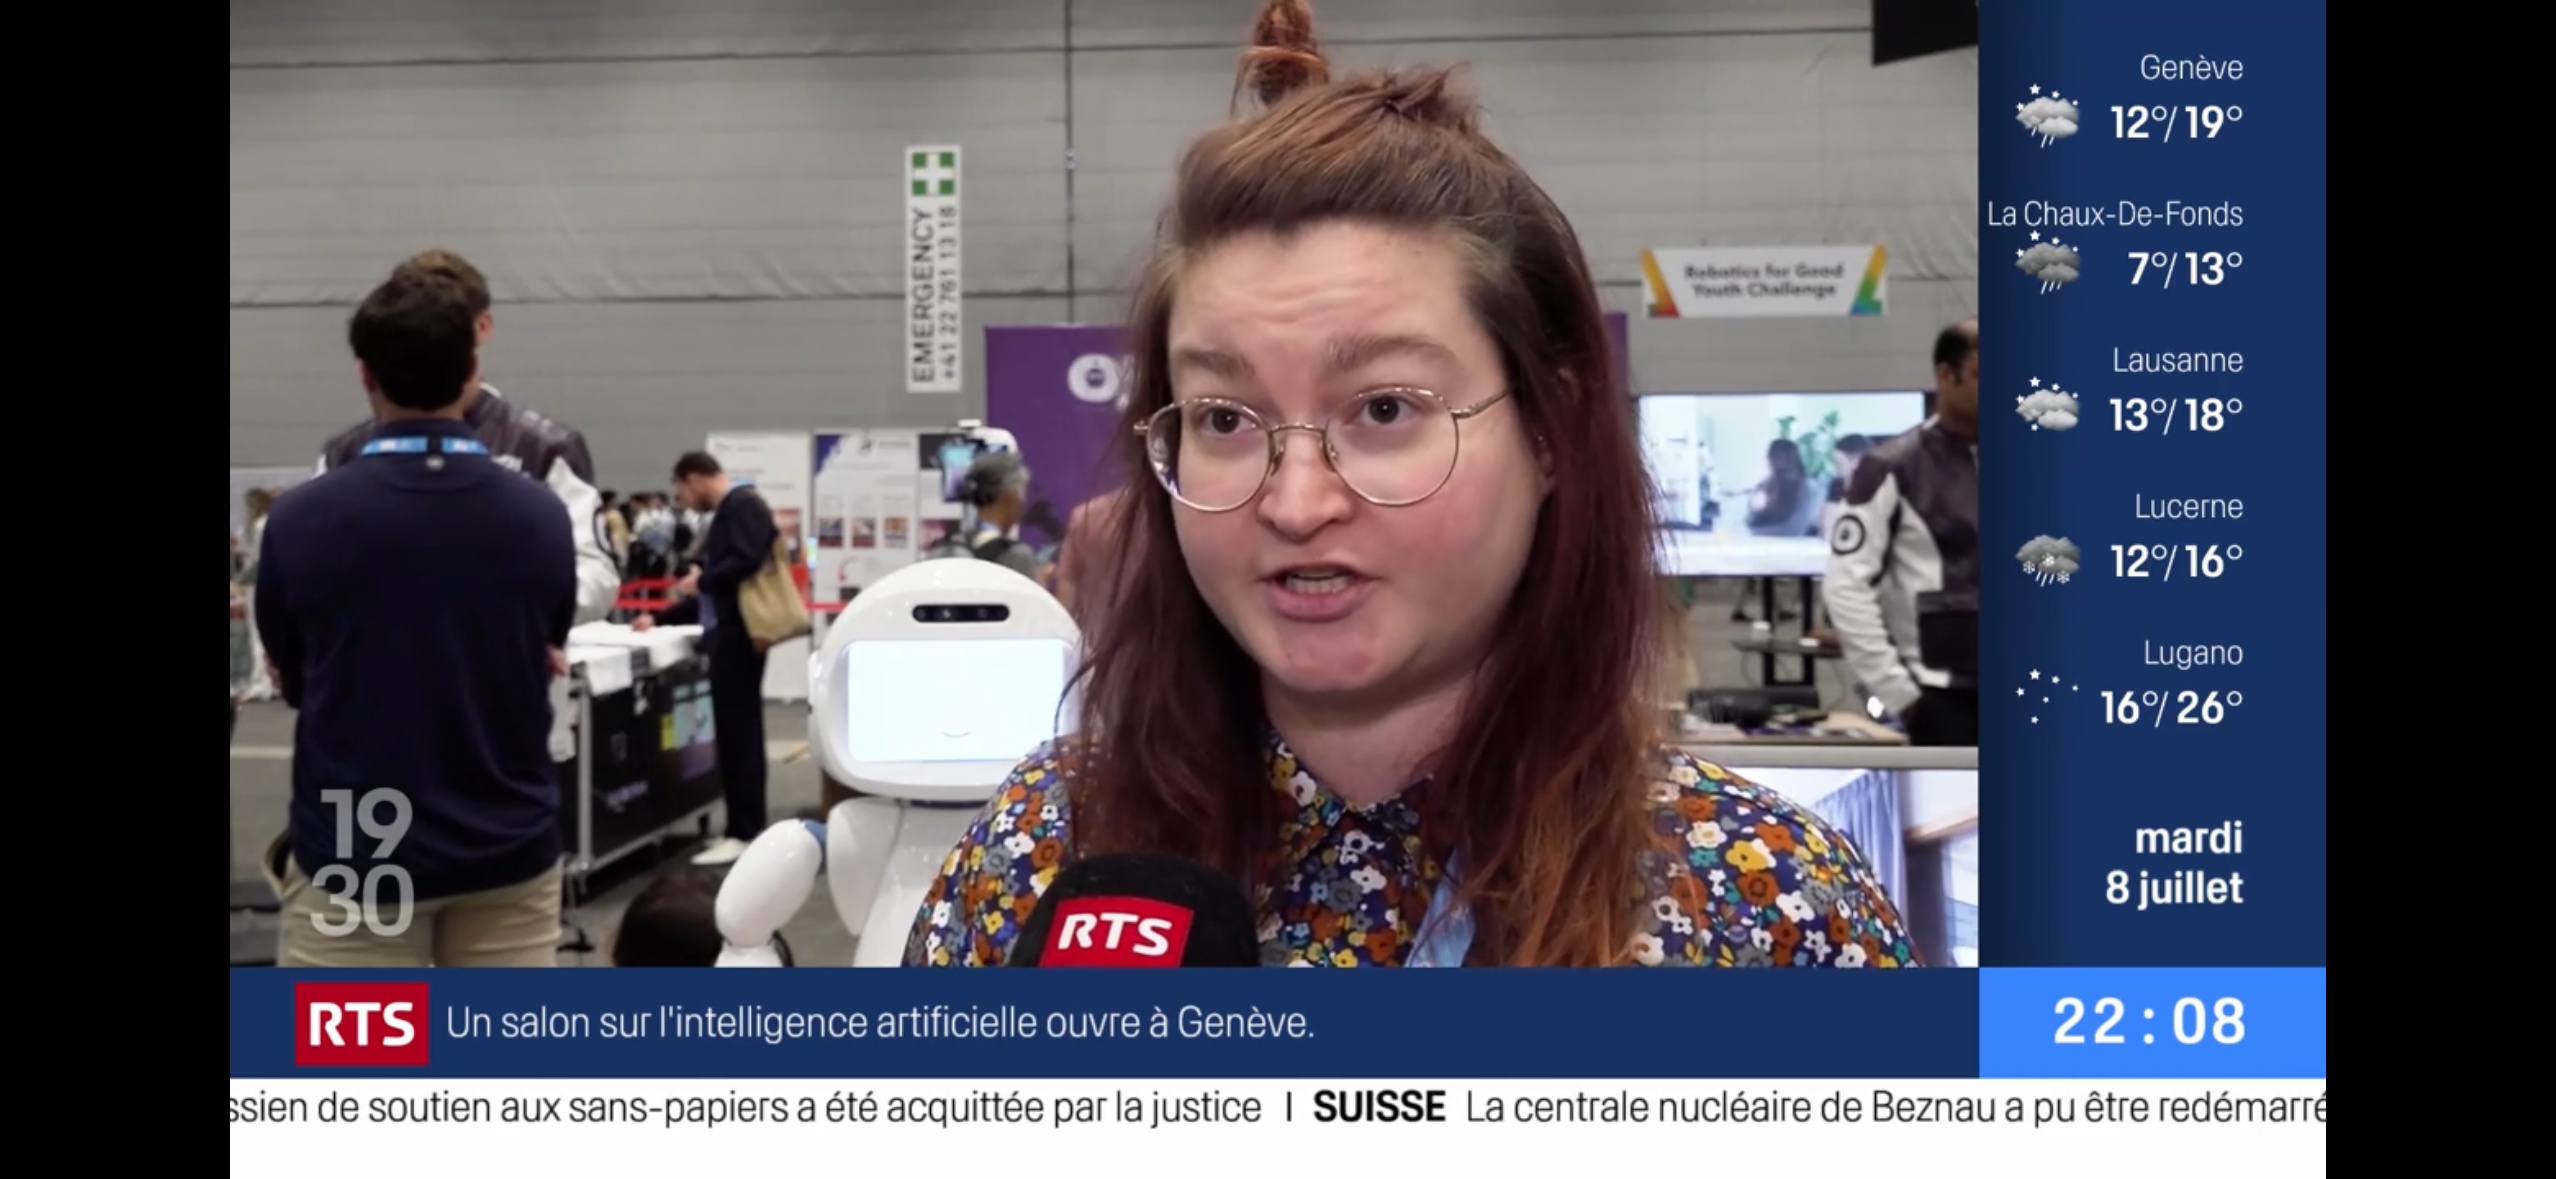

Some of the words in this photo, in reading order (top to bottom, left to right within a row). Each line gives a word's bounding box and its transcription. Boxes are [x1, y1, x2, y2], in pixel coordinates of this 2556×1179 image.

[1684, 262, 1760, 279] Robotics
[1765, 261, 1790, 278] for
[1794, 260, 1844, 278] Good
[912, 206, 936, 383] EMERGENCY
[1691, 282, 1742, 298] Youth
[1747, 280, 1837, 301] Challenge
[1057, 911, 1174, 957] RTS
